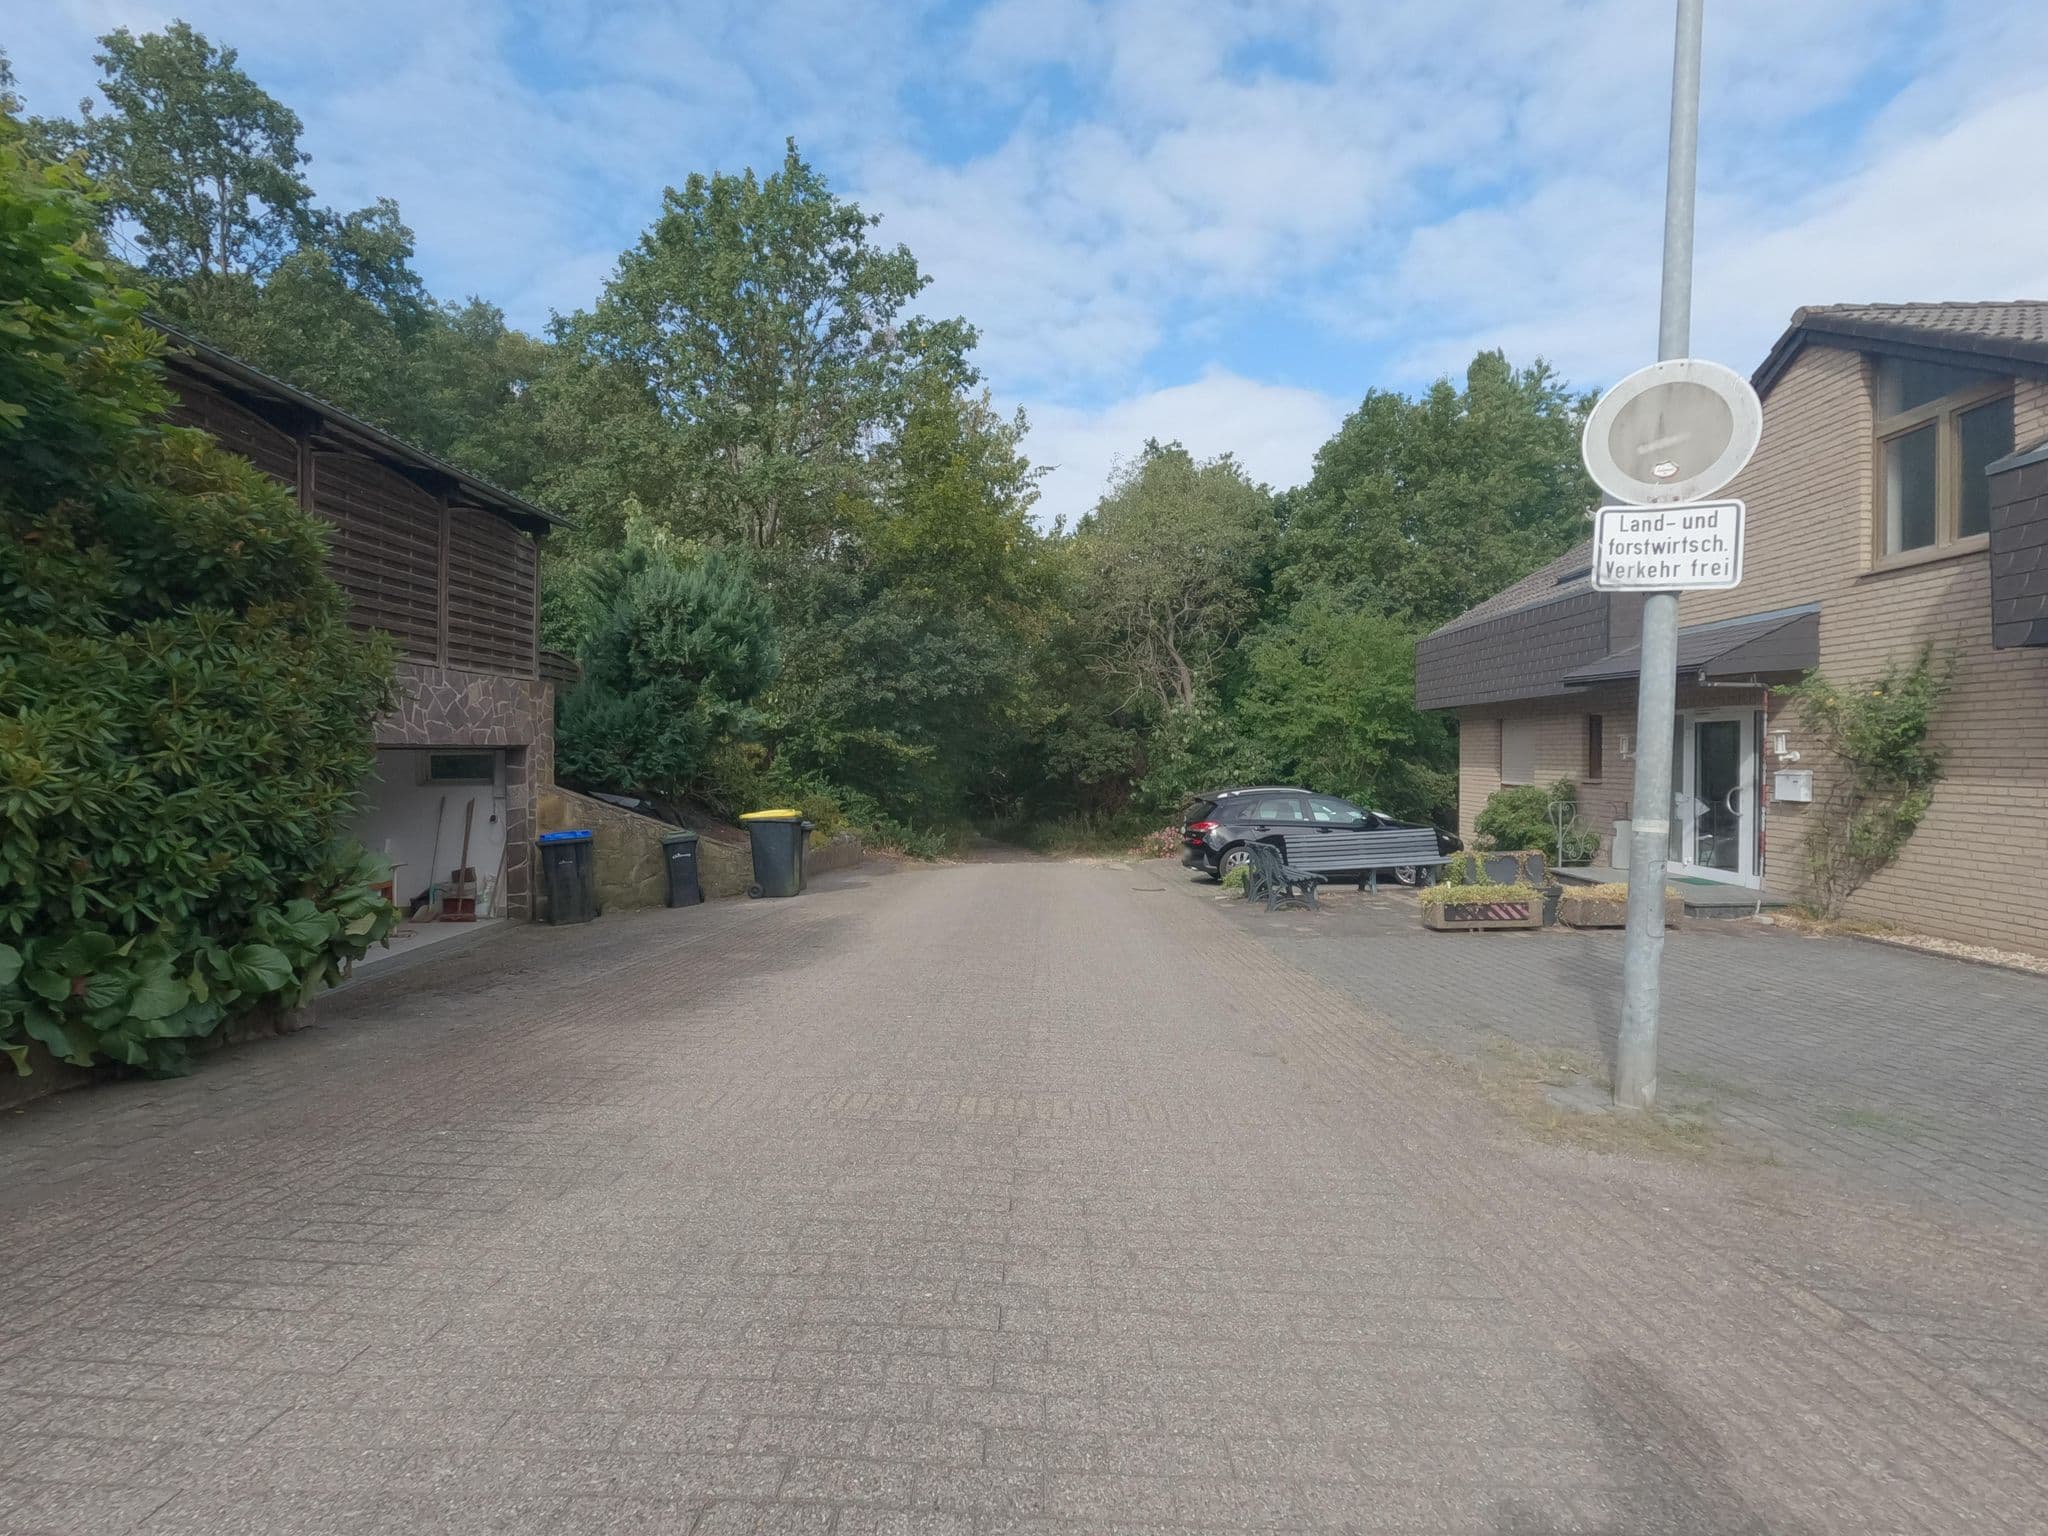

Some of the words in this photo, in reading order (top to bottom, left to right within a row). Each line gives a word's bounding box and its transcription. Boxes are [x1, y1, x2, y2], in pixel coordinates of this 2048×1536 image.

[1619, 513, 1676, 533] Land-
[1682, 510, 1718, 530] und
[1608, 534, 1729, 556] forstwirtsch.
[1605, 561, 1681, 580] Verkehr
[1691, 557, 1729, 577] frei
